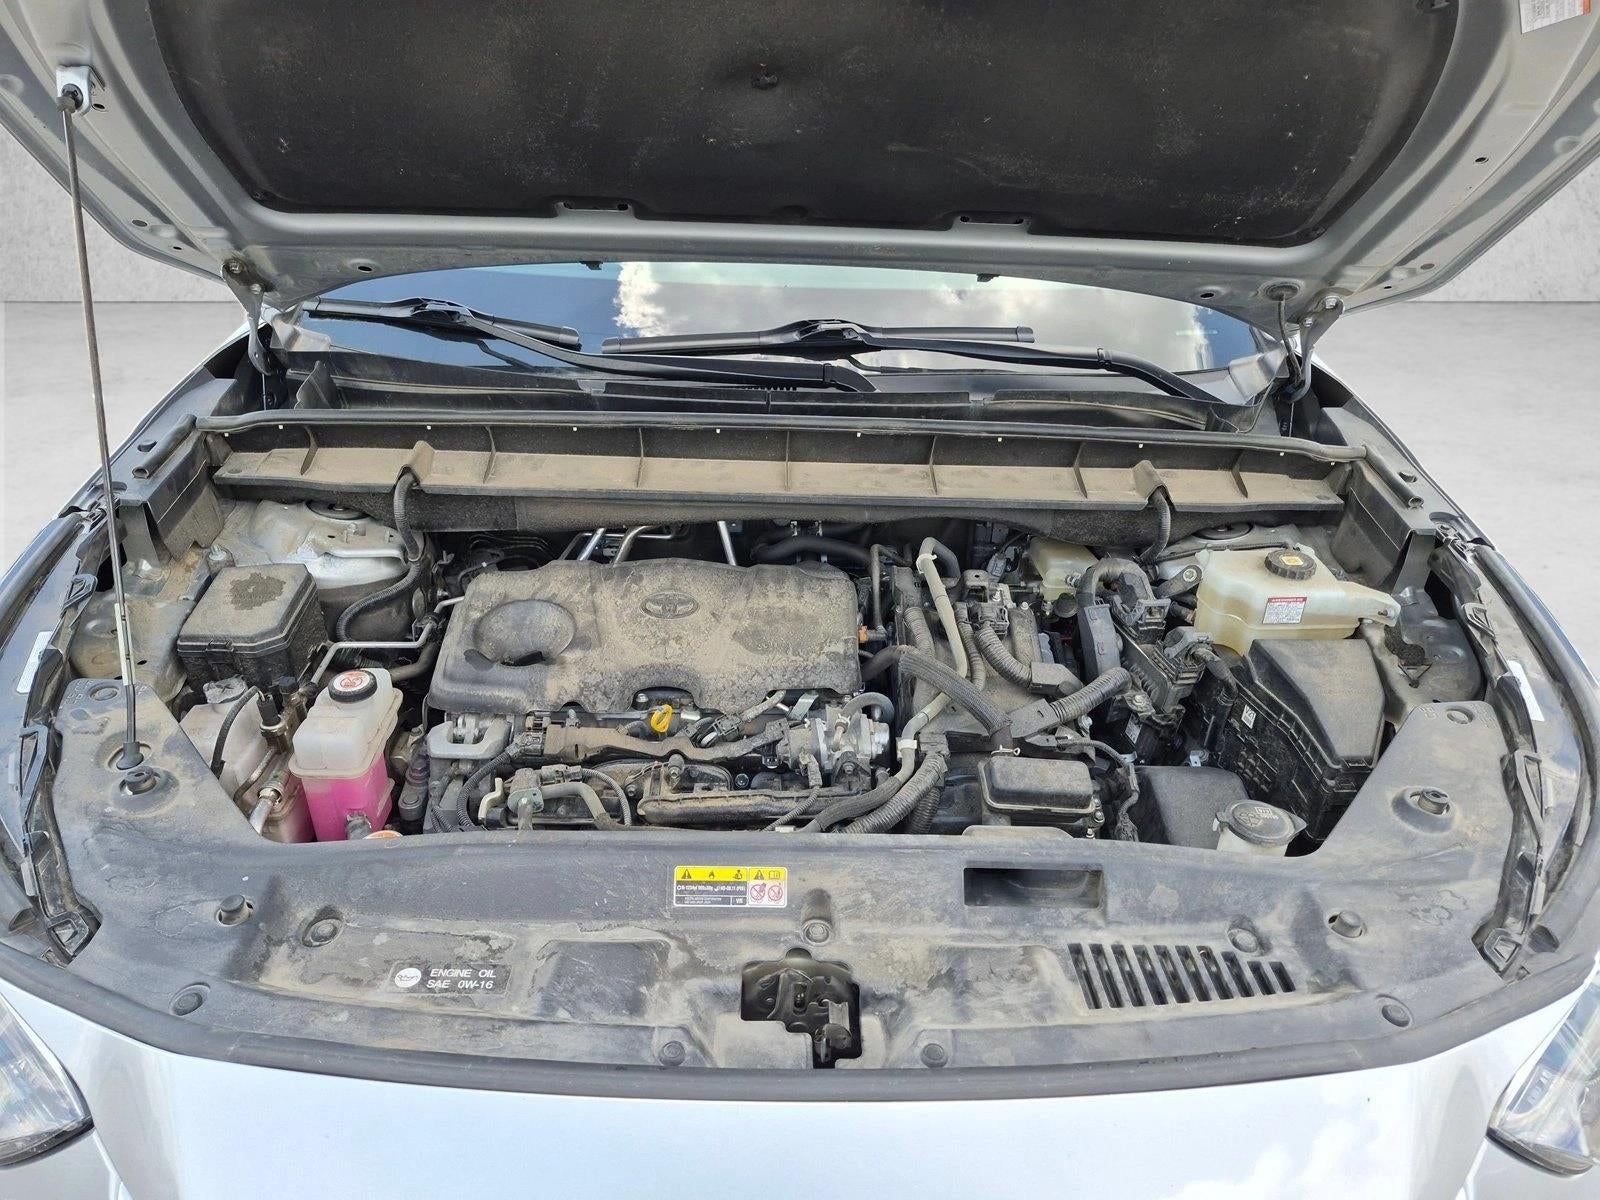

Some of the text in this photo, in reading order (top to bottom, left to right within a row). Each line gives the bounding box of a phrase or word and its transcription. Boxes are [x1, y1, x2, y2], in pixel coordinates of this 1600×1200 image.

[430, 969, 497, 978] ENGINE OIL
[426, 980, 494, 989] SAE 0W-16
